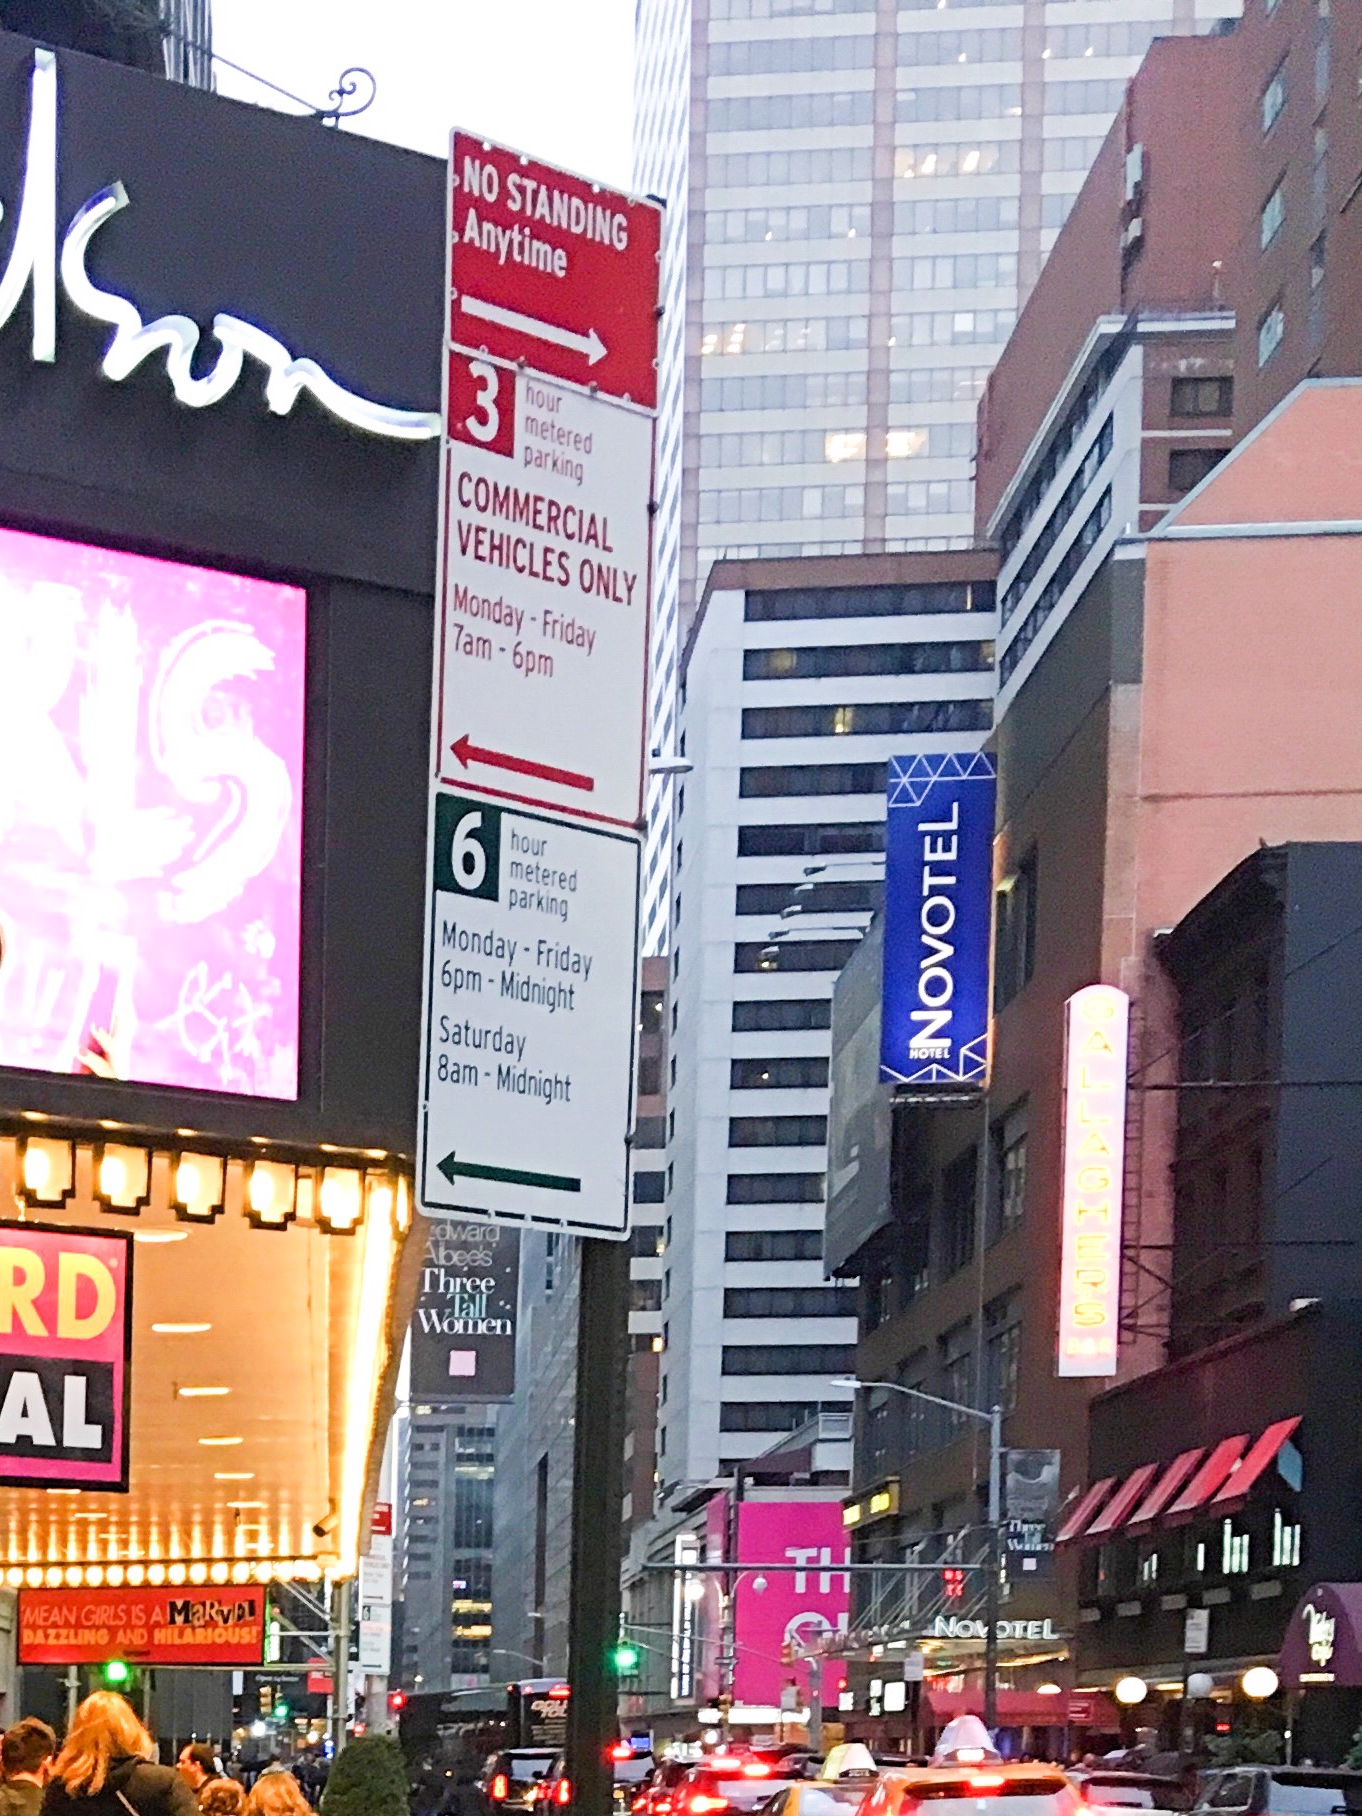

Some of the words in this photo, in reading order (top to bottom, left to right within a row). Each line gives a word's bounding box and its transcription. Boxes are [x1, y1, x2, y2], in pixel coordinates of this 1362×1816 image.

[464, 155, 499, 203] NO
[507, 172, 628, 251] STANDING
[464, 208, 568, 278] Anytime
[465, 360, 500, 443] 3
[526, 380, 561, 414] hour
[525, 412, 593, 455] metered
[524, 445, 584, 487] parking
[457, 471, 614, 553] COMMERCIAL
[457, 519, 570, 587] VEHICLES
[579, 557, 637, 607] ONLY
[453, 583, 525, 637] Monday
[542, 608, 597, 657] Friday
[452, 623, 492, 662] 7am
[512, 640, 554, 679] 6pm
[451, 810, 487, 891] 6
[511, 828, 547, 857] hour
[510, 860, 578, 893] metered
[508, 888, 568, 922] parking
[909, 801, 959, 1049] NOVOTEL
[441, 919, 518, 965] Monday
[537, 939, 594, 982] Friday
[440, 959, 483, 1001] 6pm
[500, 970, 576, 1014] Midnight
[439, 1015, 527, 1062] Saturday
[909, 1047, 950, 1060] HOTEL
[437, 1054, 479, 1087] 8am
[496, 1062, 572, 1106] Midnight
[1072, 992, 1115, 1328] GALLAGHERS
[422, 1267, 496, 1294] Three
[446, 1293, 487, 1318] Tall
[416, 1308, 512, 1335] Women
[22, 1628, 110, 1646] DAZZLING
[115, 1628, 149, 1646] AND
[81, 1604, 127, 1627] GIRLS
[131, 1604, 147, 1627] IS
[149, 1604, 165, 1626] A
[934, 1615, 1060, 1640] NOVOTEL
